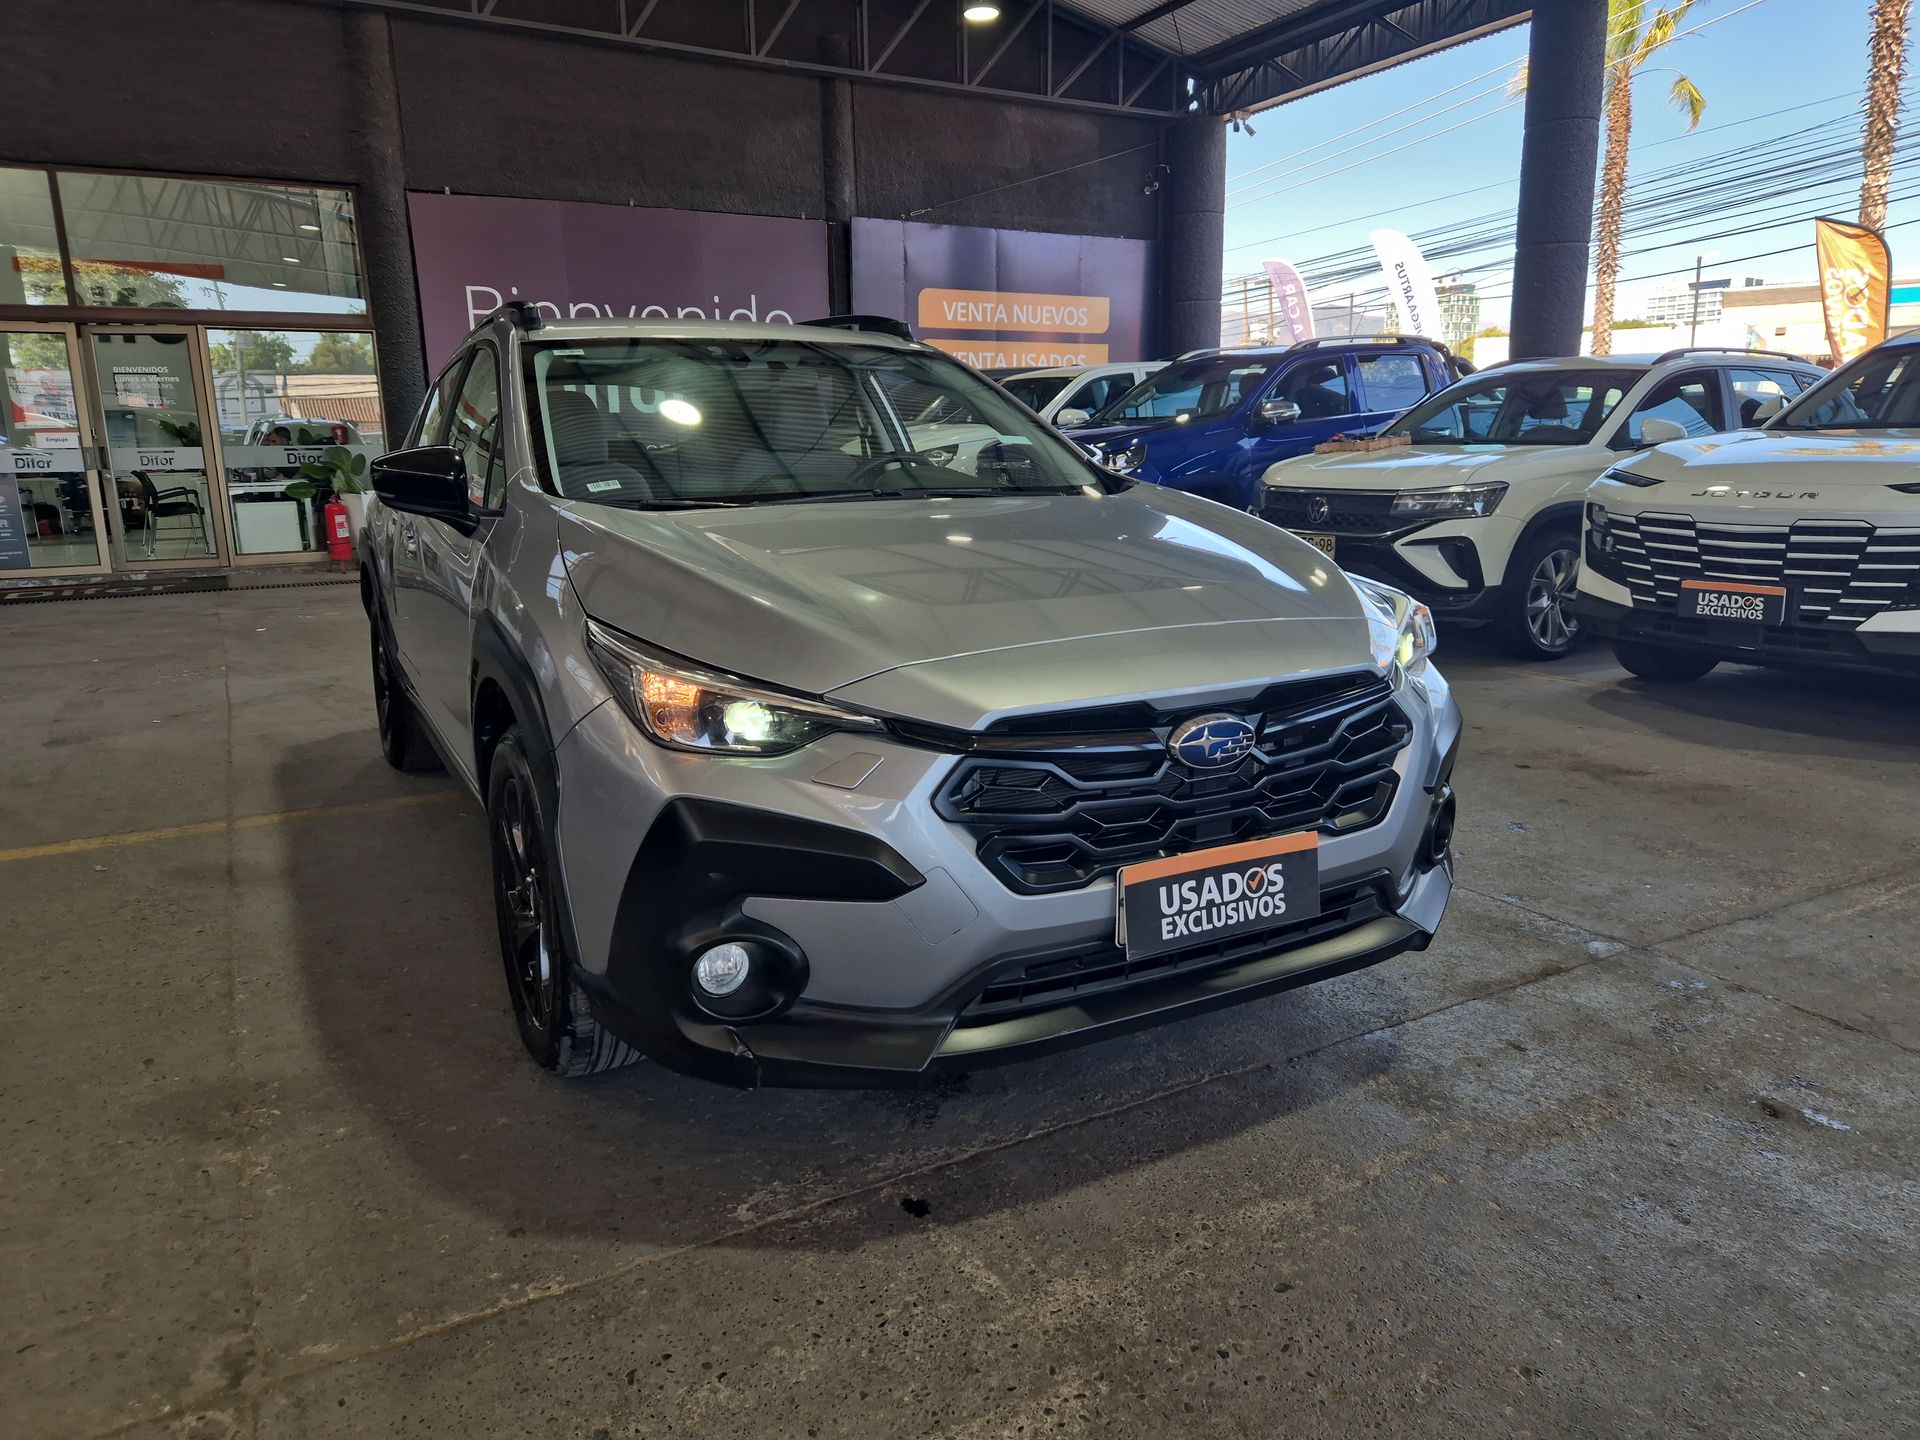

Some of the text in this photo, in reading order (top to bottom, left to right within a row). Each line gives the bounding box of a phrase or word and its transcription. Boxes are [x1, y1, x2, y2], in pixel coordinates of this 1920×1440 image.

[943, 301, 1089, 326] VENTA NUEVOS
[953, 351, 1087, 369] ENTA USADOS
[115, 375, 140, 383] Lunes
[147, 375, 180, 383] Viernes
[1697, 592, 1765, 610] USADOS
[1696, 605, 1764, 620] EXCLUSIVOS
[1159, 863, 1285, 915] USADOS
[1161, 892, 1287, 940] EXCLUSIVOS
